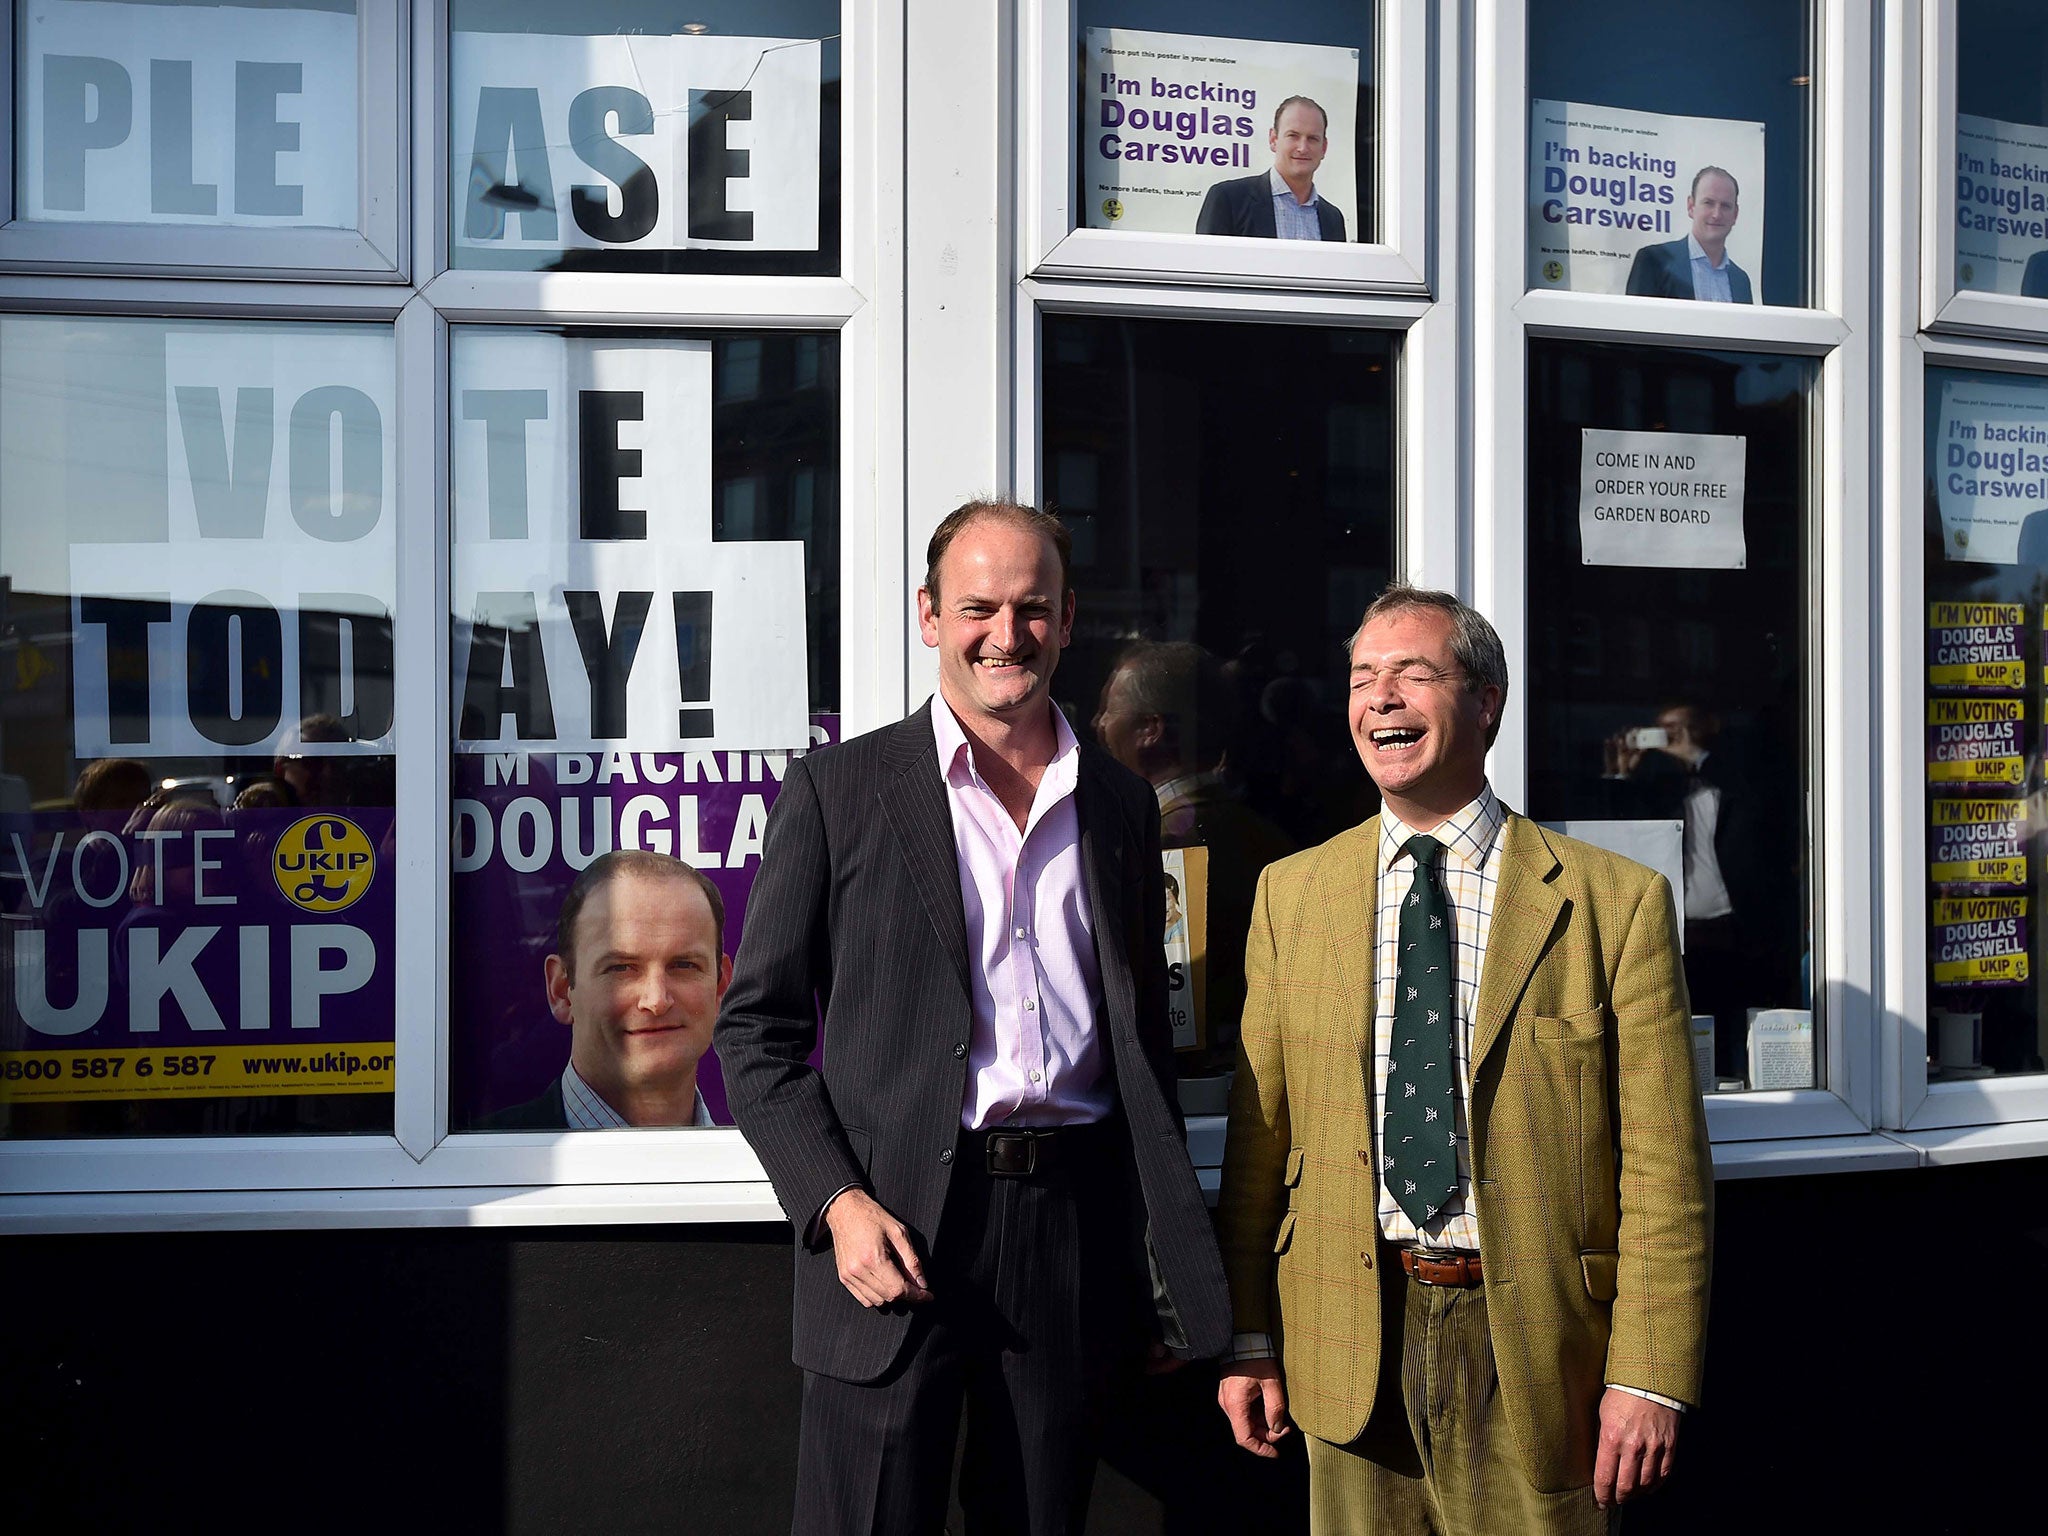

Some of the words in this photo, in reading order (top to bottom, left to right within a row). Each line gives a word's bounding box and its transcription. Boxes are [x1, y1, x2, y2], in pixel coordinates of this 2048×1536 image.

[1101, 47, 1125, 55] Please
[1209, 56, 1237, 64] window
[1151, 77, 1256, 110] backing
[1100, 99, 1254, 140] Douglas
[1099, 134, 1249, 168] Carswell
[1588, 146, 1676, 178] backing
[1990, 157, 2048, 183] backin
[1132, 186, 1161, 195] leaflets,
[1544, 166, 1674, 206] Douglas
[1958, 176, 2048, 215] Dougla
[1542, 199, 1670, 233] Carswell
[1958, 206, 2048, 239] Carswel
[1983, 422, 2048, 447] backin
[175, 386, 647, 542] VOTE
[1595, 452, 1639, 468] COME
[1644, 455, 1659, 469] IN
[1664, 455, 1696, 470] AND
[1595, 479, 1645, 495] ORDER
[1649, 481, 1689, 497] YOUR
[1693, 483, 1727, 498] FREE
[1947, 473, 2048, 499] Carswel
[1594, 506, 1655, 522] GARDEN
[1660, 508, 1711, 524] BOARD
[1938, 605, 1959, 623] I'M
[1964, 605, 2017, 624] VOTING
[1942, 626, 2014, 645] DOUGLAS
[1938, 644, 2020, 664] CARSWELL
[1976, 666, 2007, 678] UKIP
[1937, 702, 1958, 720] I'M
[1963, 702, 2017, 720] VOTING
[1941, 722, 2014, 742] DOUGLAS
[1936, 740, 2019, 760] CARSWELL
[1975, 762, 2005, 774] UKIP
[1941, 803, 1960, 820] I'M
[1966, 803, 2019, 821] VOTING
[453, 794, 768, 873] DOUGLA
[1944, 822, 2017, 842] DOUGLAS
[278, 852, 370, 871] UKIP
[1939, 840, 2022, 862] CARSWELL
[10, 830, 238, 908] VOTE
[1978, 863, 2008, 875] UKIP
[1942, 902, 1962, 920] I'M
[1968, 900, 2020, 919] VOTING
[1946, 920, 2016, 942] DOUGLAS
[1942, 937, 2023, 961] CARSWELL
[1980, 960, 2009, 973] UKIP
[14, 924, 376, 1035] UKIP
[0, 1059, 62, 1080] 800
[72, 1057, 125, 1078] 587
[135, 1057, 153, 1077] 6
[163, 1055, 216, 1076] 587
[243, 1052, 395, 1076] www.ukip.or
